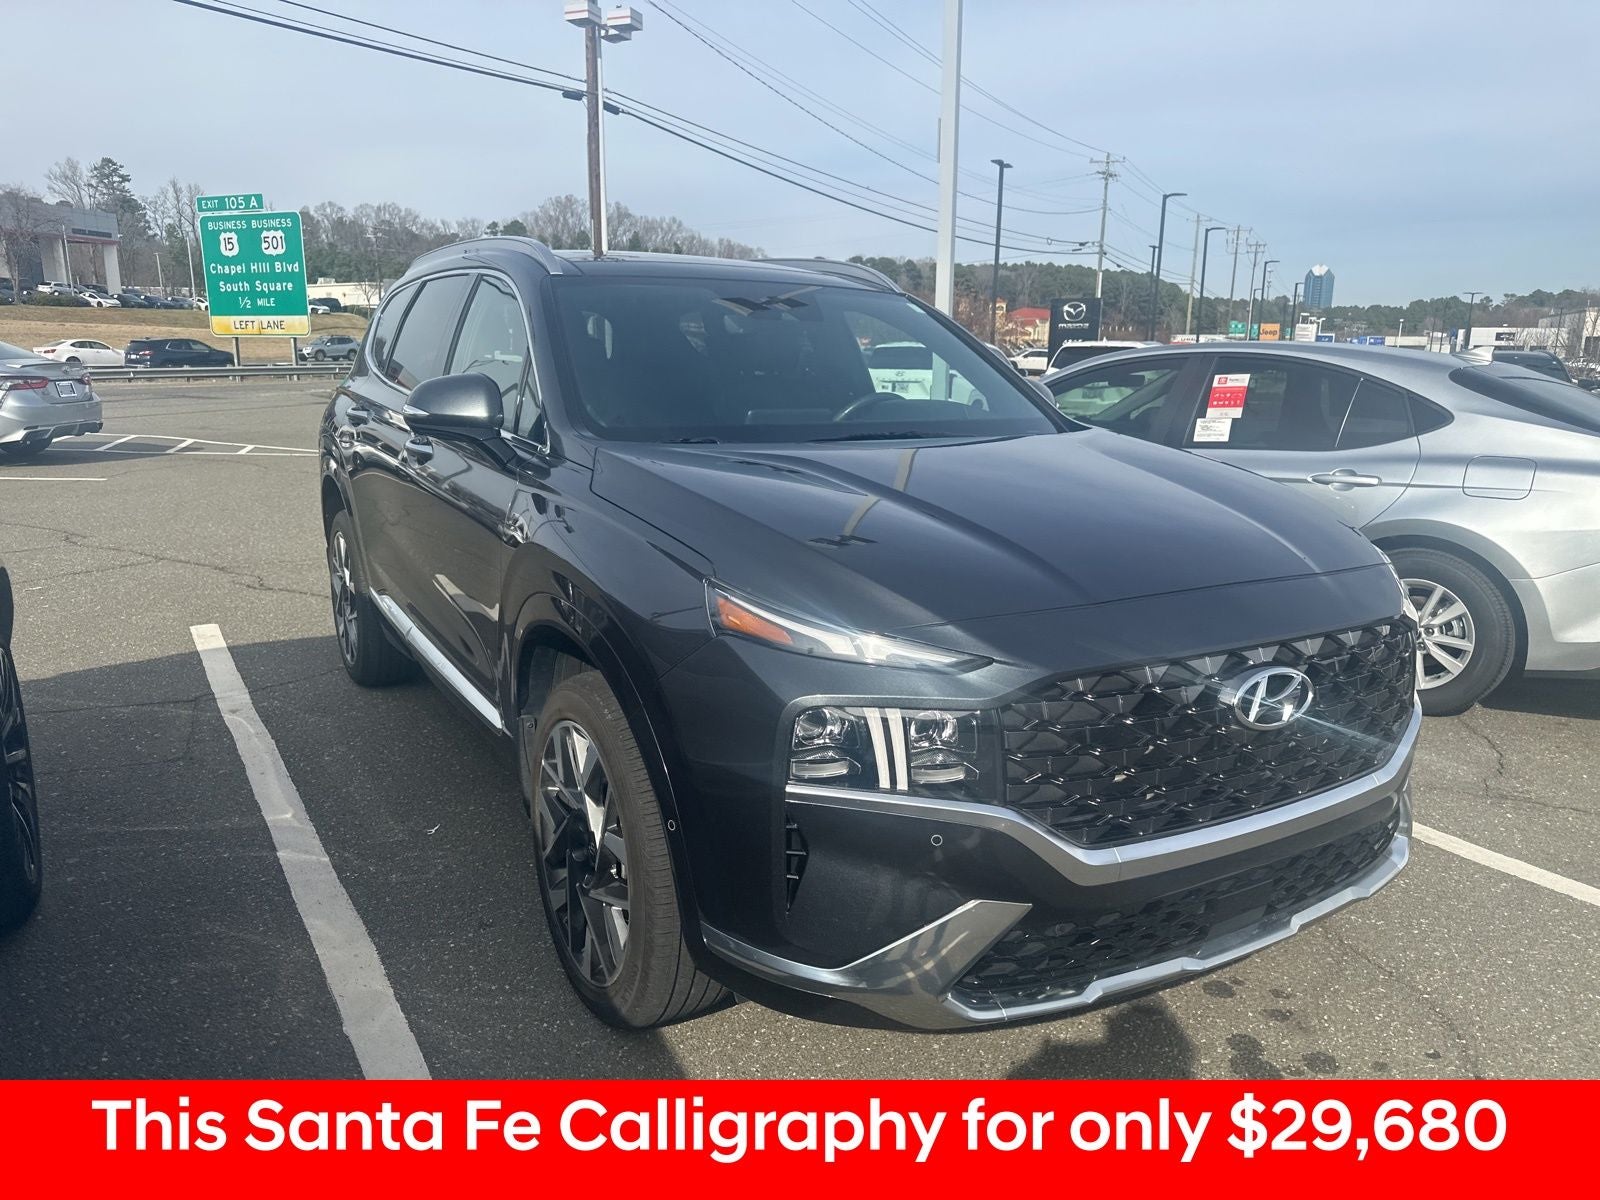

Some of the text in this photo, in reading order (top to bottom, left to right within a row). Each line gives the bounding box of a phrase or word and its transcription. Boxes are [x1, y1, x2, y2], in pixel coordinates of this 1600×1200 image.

[202, 195, 259, 210] EXIT 105 A
[207, 218, 292, 231] BUSINESS BUSINESS
[223, 236, 235, 252] 15
[263, 235, 284, 251] 501
[210, 261, 300, 275] Chapel Hill Blvd
[219, 280, 294, 294] South Square
[256, 297, 276, 307] MILE
[233, 320, 286, 330] LEFT LANE
[1260, 327, 1278, 337] Jeep
